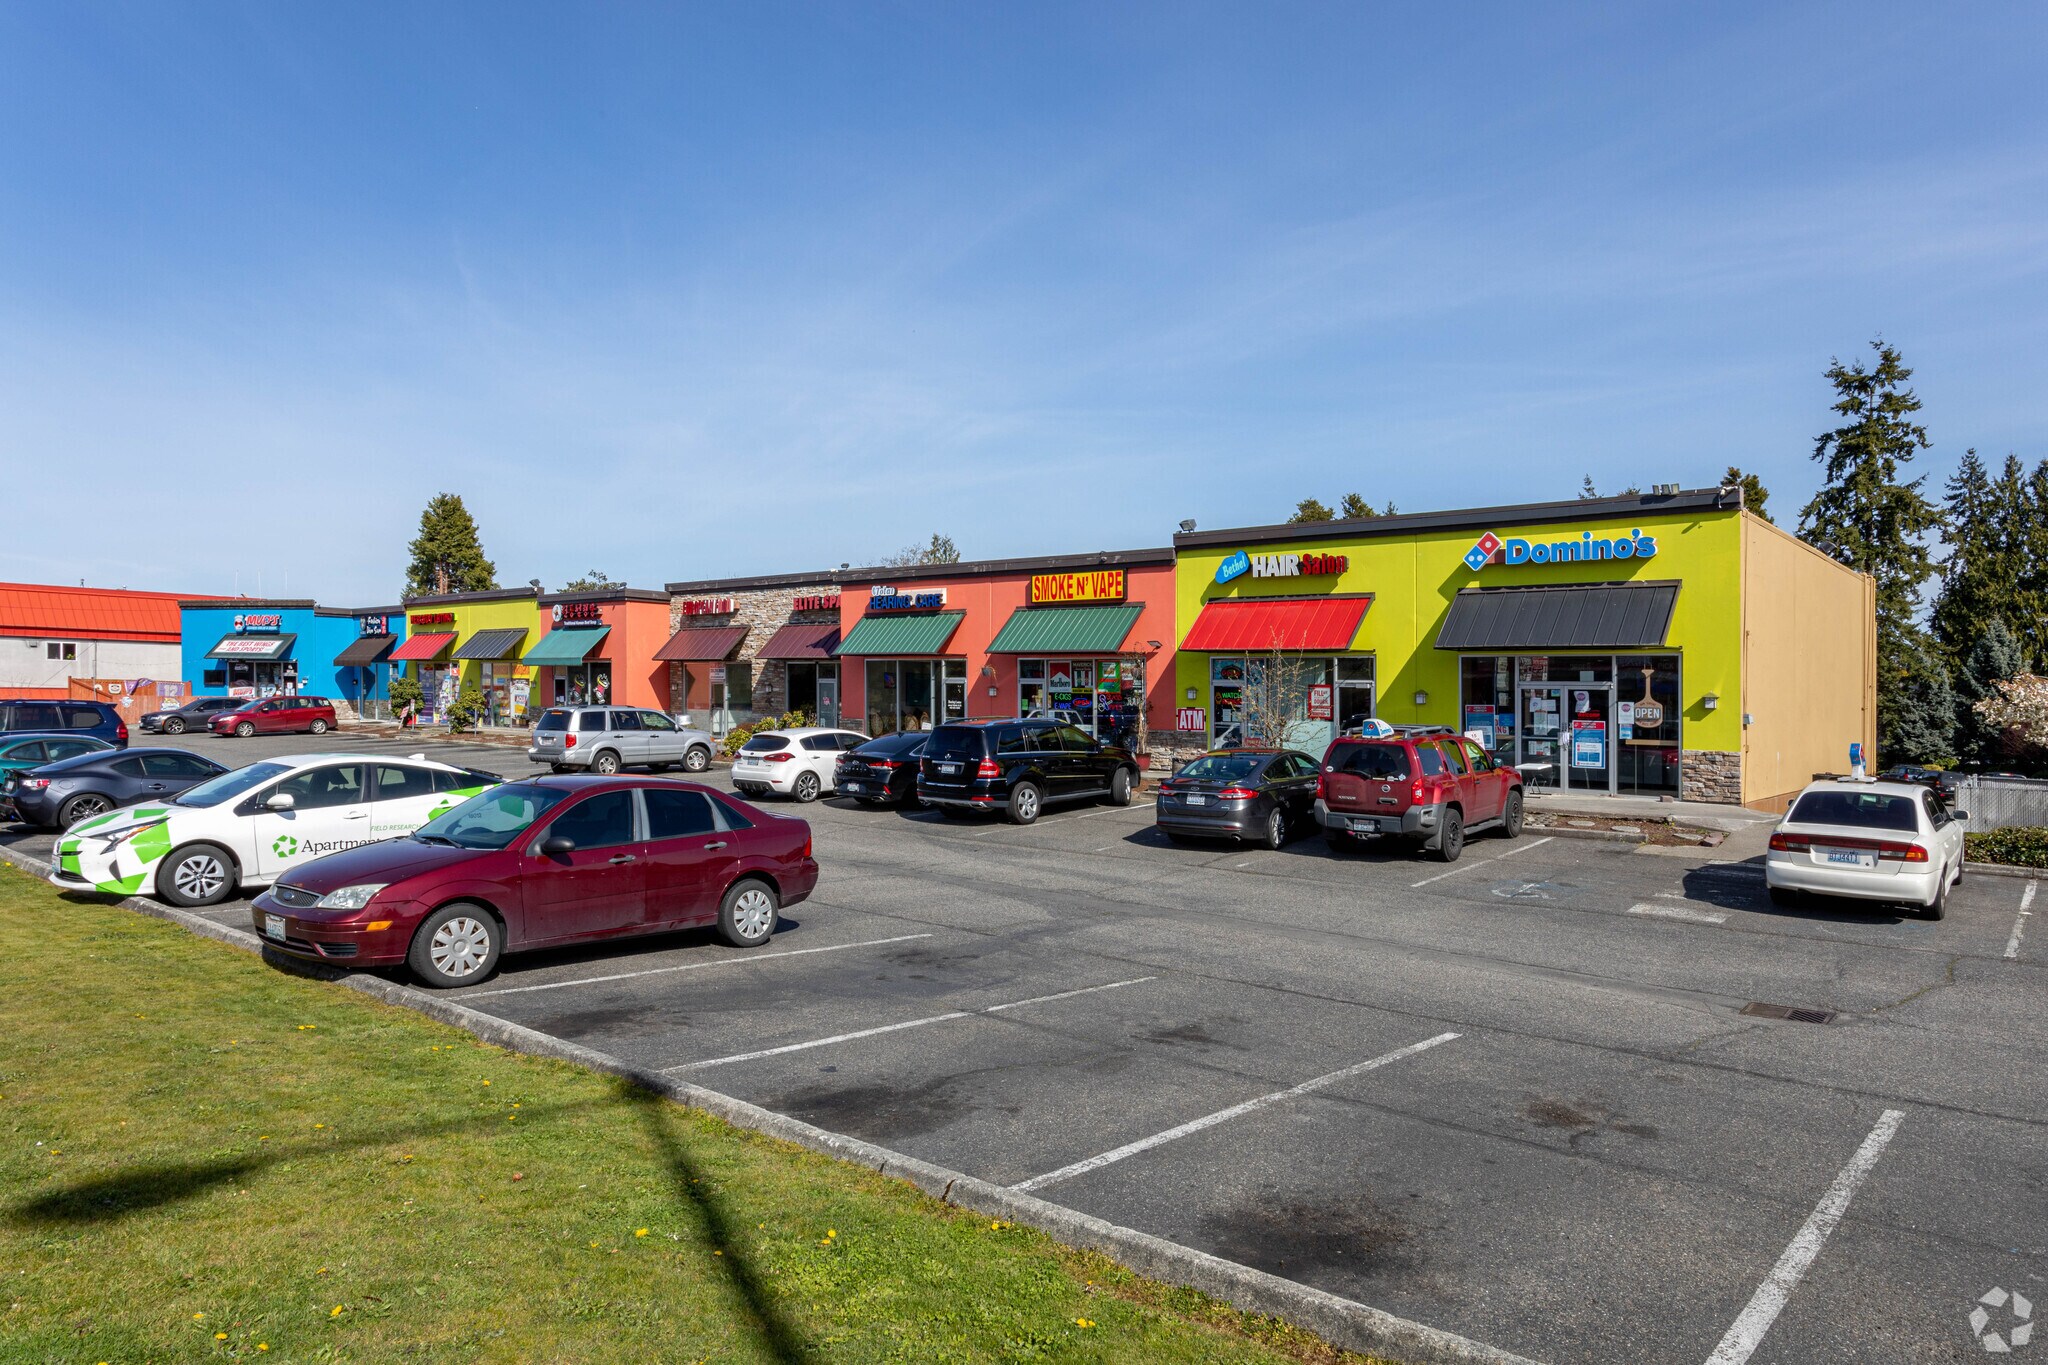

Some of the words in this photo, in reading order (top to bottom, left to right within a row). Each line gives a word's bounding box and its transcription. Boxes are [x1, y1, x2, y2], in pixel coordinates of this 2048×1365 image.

[1505, 528, 1658, 565] Domino's
[1222, 555, 1247, 578] Bethel
[1252, 554, 1300, 578] HAIR
[1302, 553, 1347, 575] Salon
[872, 586, 896, 596] Total
[1034, 574, 1074, 601] SMOKE
[1076, 576, 1089, 596] N'
[1091, 571, 1123, 598] VAPE
[682, 600, 714, 615] EUROPEAN
[793, 596, 820, 611] ELITE
[869, 595, 912, 609] HEARING
[914, 594, 943, 608] CARE
[164, 684, 178, 697] 12
[1050, 679, 1071, 688] Marlboro
[1054, 693, 1072, 701] E-CIGS
[1054, 702, 1072, 710] E-VAPE
[1635, 707, 1660, 719] OPEN
[1179, 710, 1203, 730] ATM
[370, 824, 388, 832] FIELD
[389, 823, 422, 831] RESEARCH
